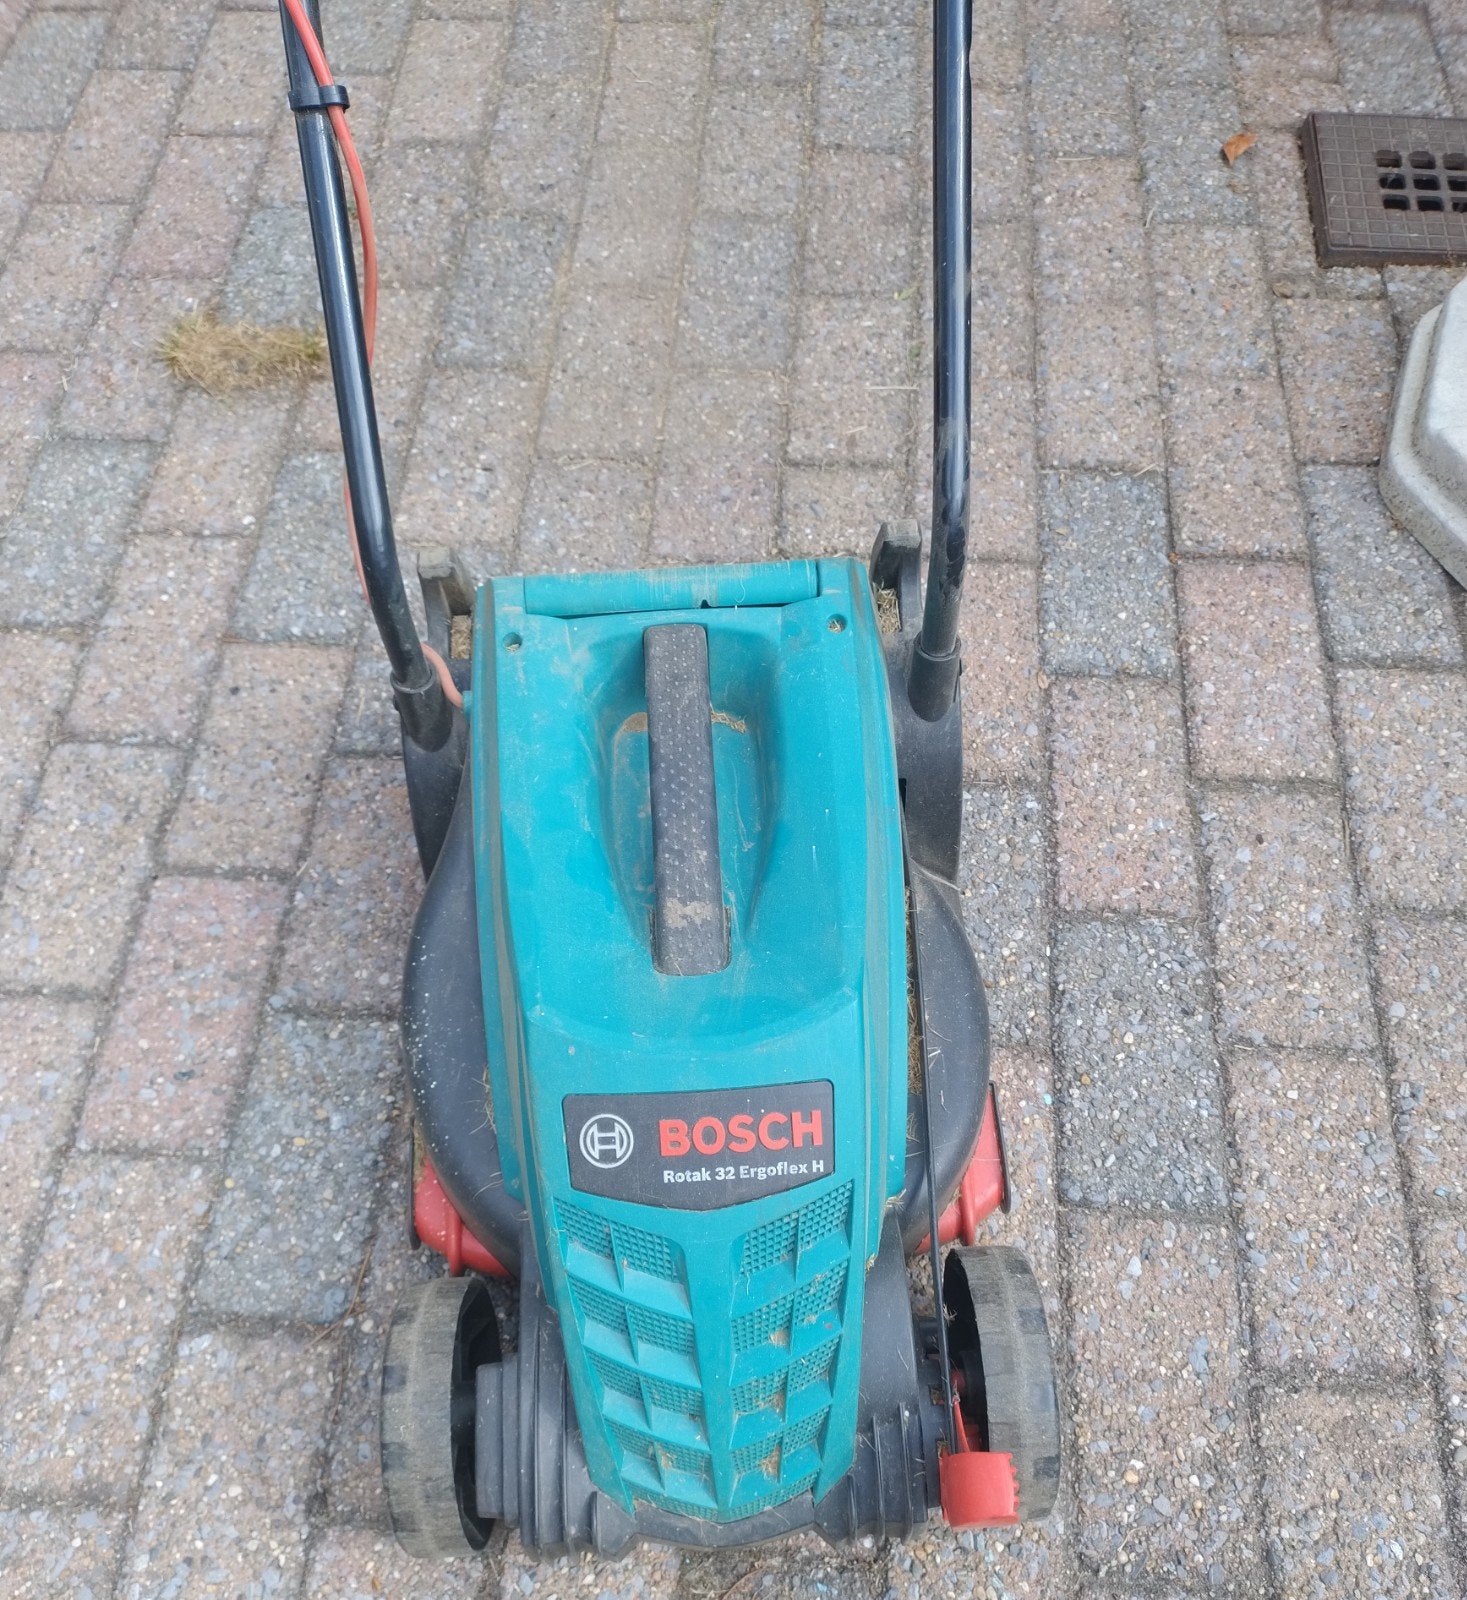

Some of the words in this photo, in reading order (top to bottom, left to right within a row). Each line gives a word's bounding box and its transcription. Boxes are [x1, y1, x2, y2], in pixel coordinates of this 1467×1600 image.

[658, 1109, 824, 1157] BOSCH
[663, 1167, 711, 1183] Rotak
[715, 1168, 735, 1180] 32
[739, 1161, 808, 1181] Ergoflex
[812, 1160, 824, 1173] H
